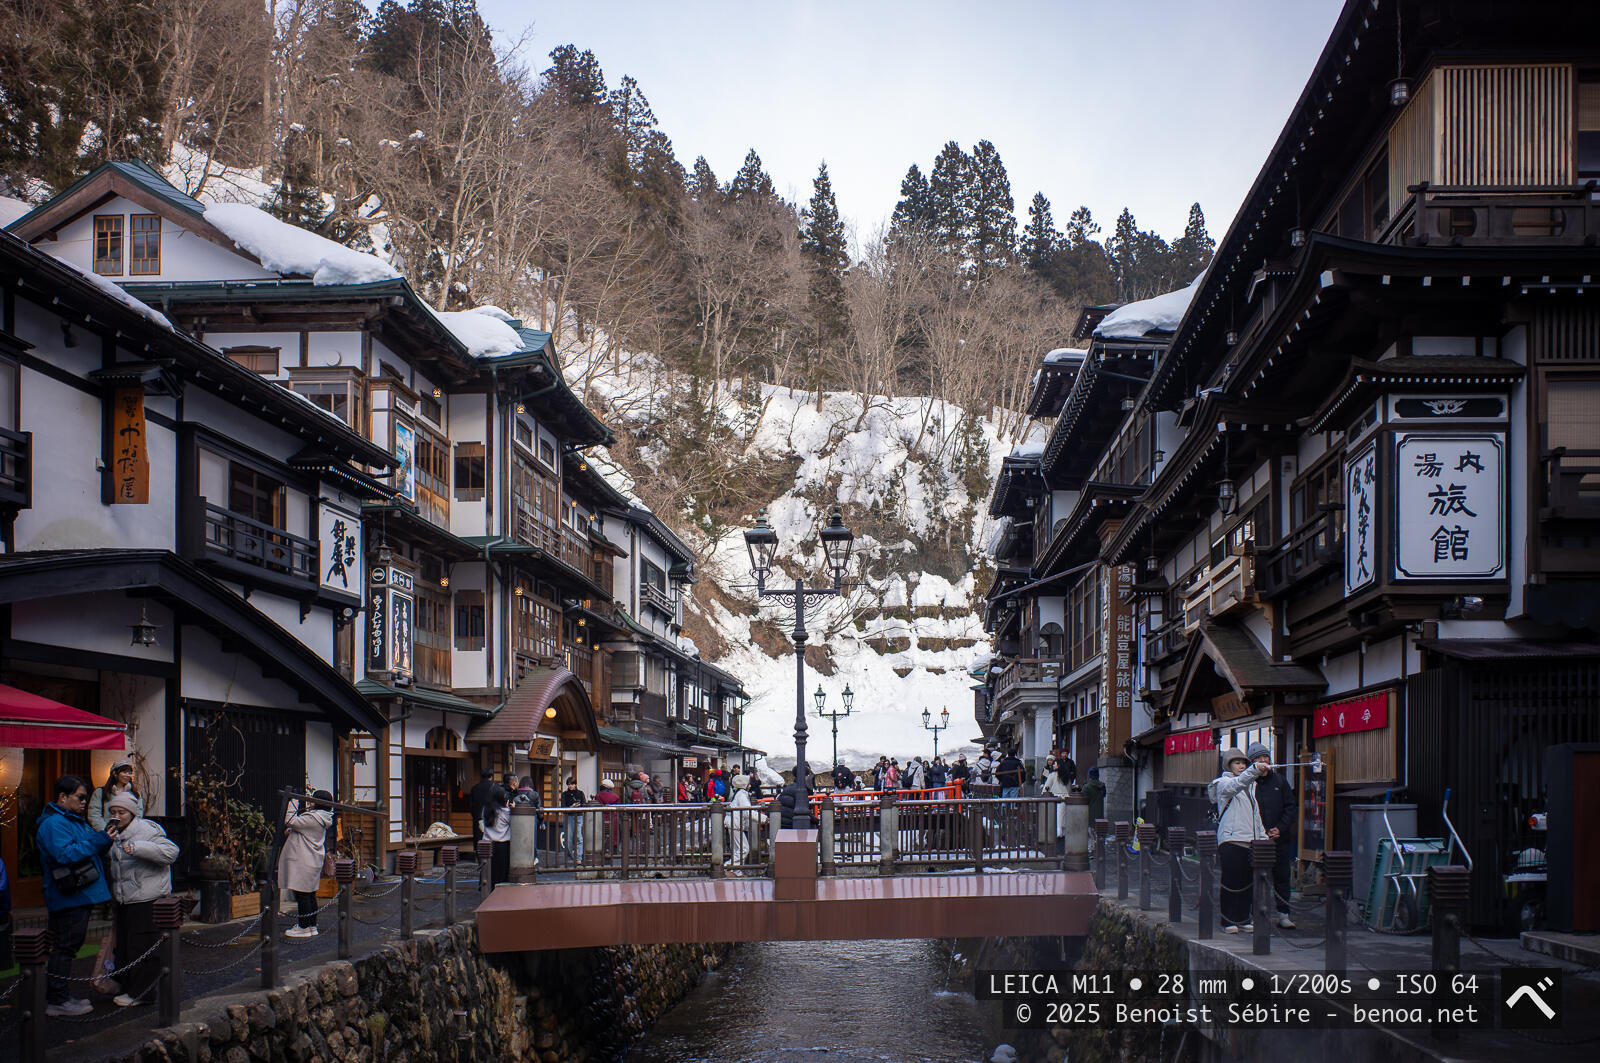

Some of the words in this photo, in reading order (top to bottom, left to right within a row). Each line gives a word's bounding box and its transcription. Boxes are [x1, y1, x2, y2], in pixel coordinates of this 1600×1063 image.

[1428, 483, 1478, 563] 旅館
[1116, 615, 1130, 708] 能登屋旅館
